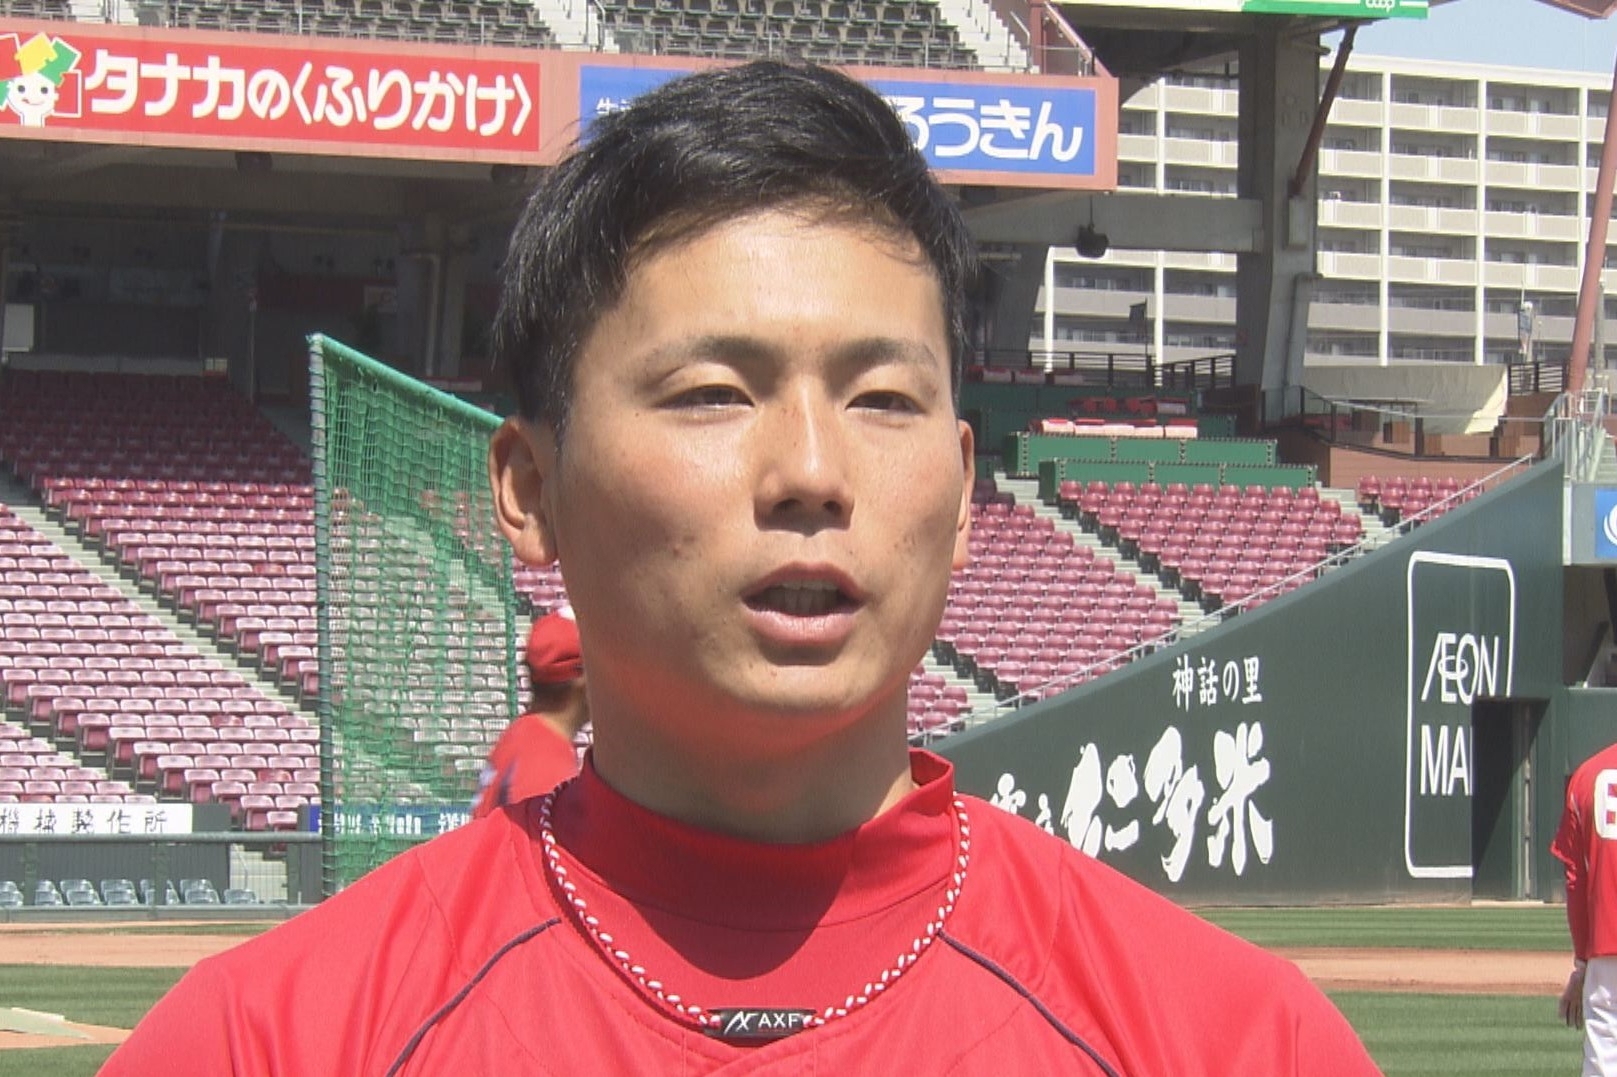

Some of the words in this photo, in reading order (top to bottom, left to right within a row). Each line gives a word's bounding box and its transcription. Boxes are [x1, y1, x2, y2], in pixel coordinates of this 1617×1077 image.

[896, 97, 1083, 162] ろうきん
[1173, 654, 1263, 711] 神話の里
[1420, 724, 1473, 796] MA
[758, 1012, 801, 1028] AXF
